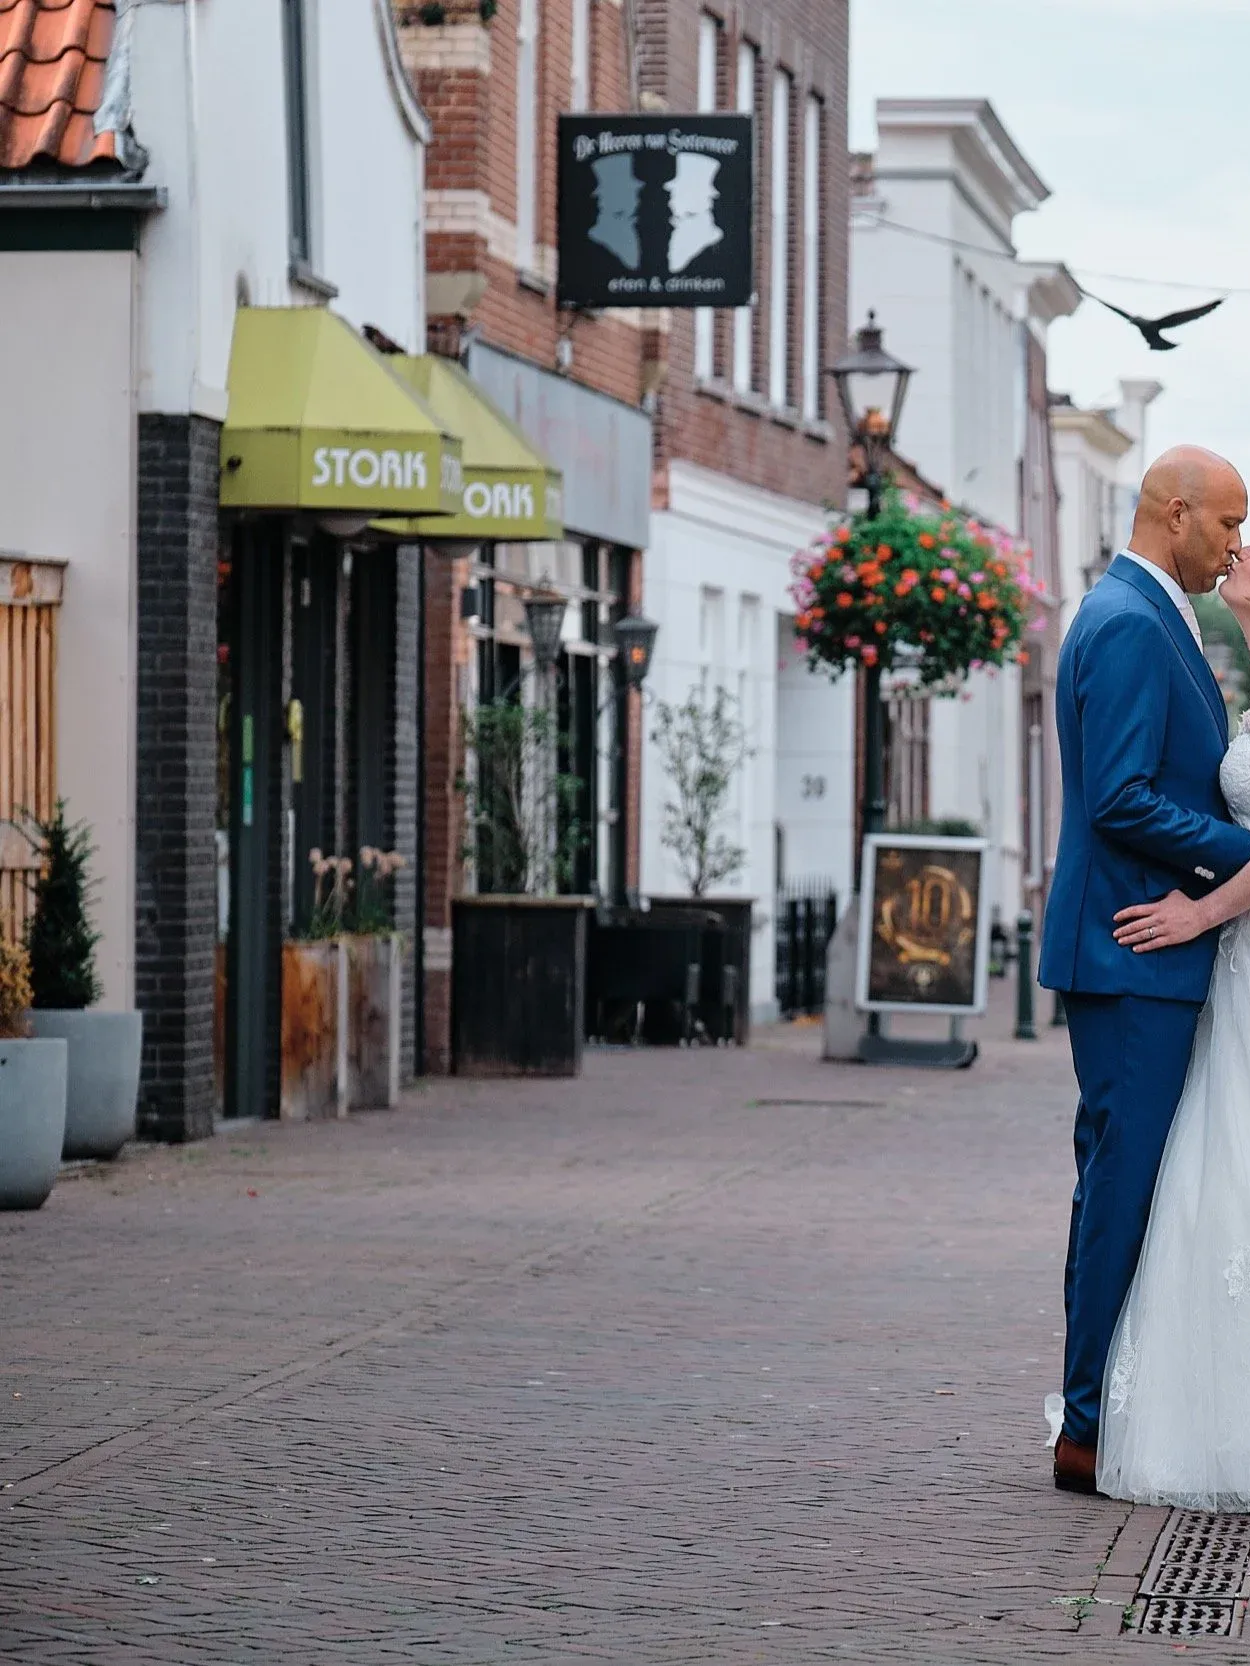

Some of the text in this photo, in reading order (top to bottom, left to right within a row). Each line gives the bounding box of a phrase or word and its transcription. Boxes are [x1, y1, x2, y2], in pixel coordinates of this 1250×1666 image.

[608, 276, 725, 293] eten & drinken
[312, 447, 427, 488] STORK
[463, 481, 533, 519] ORK
[907, 877, 949, 932] 10
